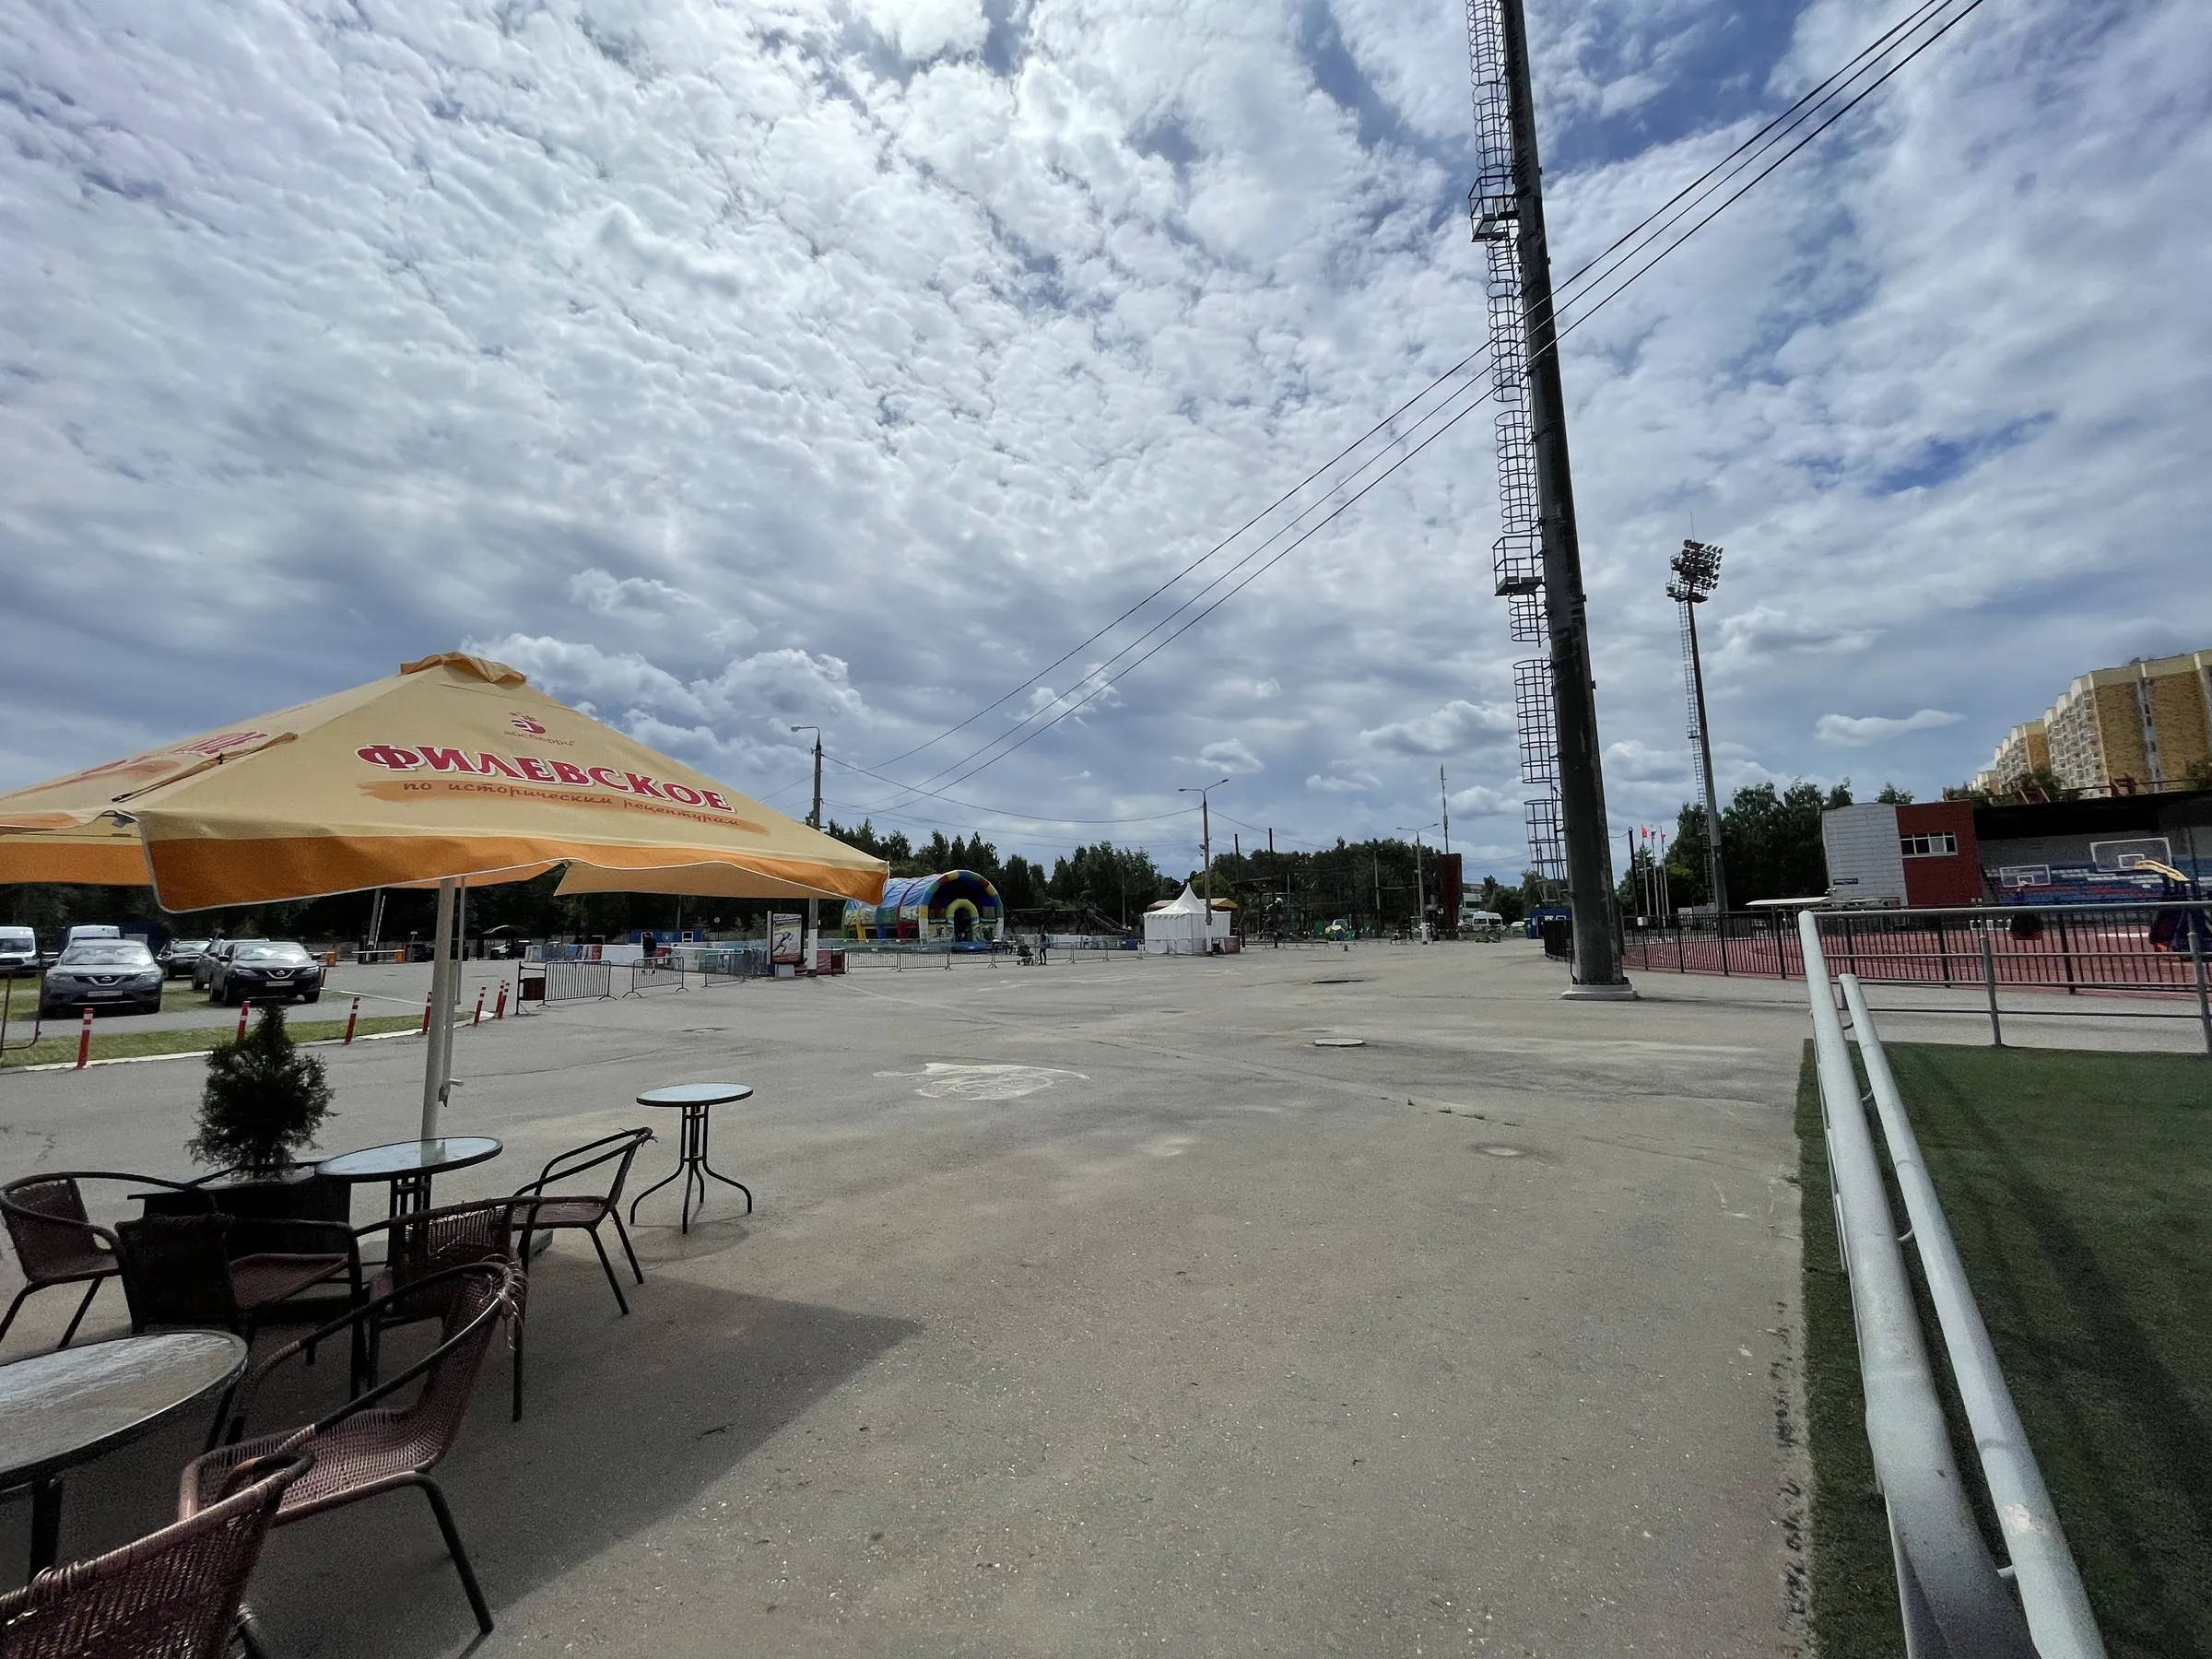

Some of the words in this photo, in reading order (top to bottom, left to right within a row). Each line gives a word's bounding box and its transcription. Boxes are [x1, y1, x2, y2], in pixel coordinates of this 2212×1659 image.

[355, 744, 736, 813] ФИЛЕВСКОЕ
[403, 782, 432, 791] по
[448, 782, 613, 805] историческим
[623, 798, 740, 827] рецептурам
